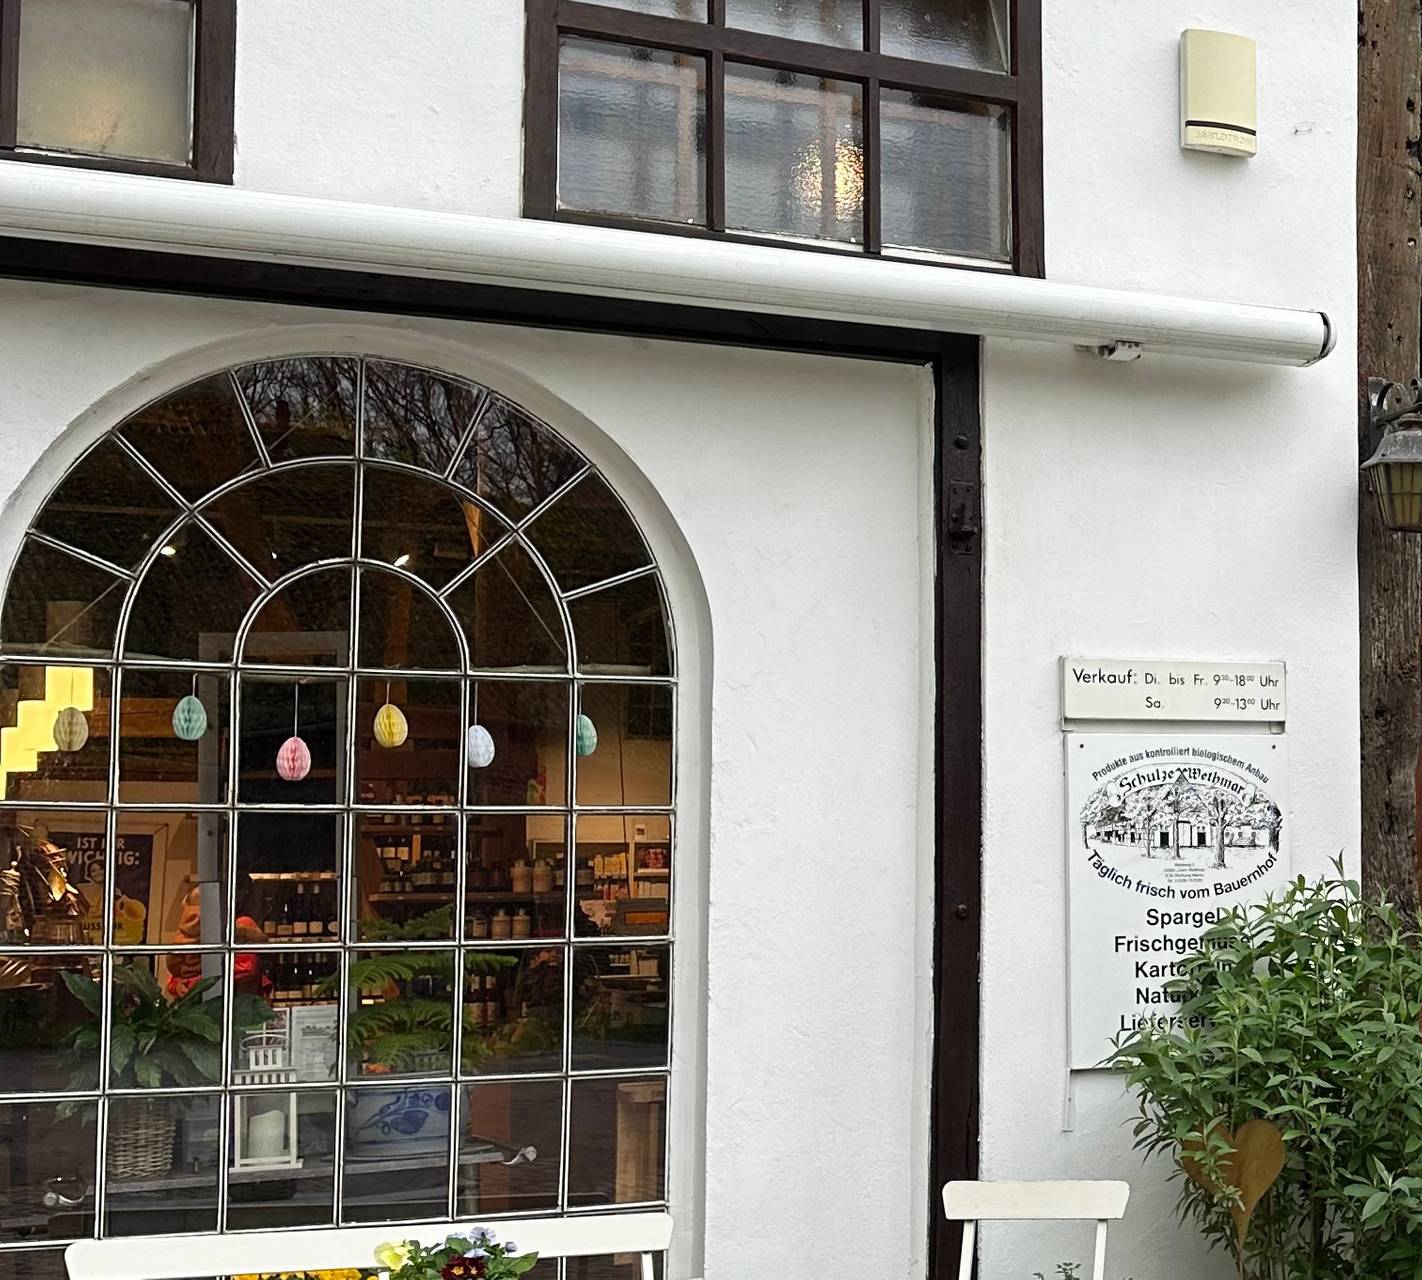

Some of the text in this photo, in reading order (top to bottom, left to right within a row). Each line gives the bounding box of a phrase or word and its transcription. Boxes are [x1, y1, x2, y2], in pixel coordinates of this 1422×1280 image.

[1072, 667, 1138, 684] Verkauf:
[1145, 672, 1161, 685] Di.
[1169, 672, 1186, 685] bis
[1193, 674, 1208, 687] Fr.
[1260, 675, 1279, 687] Uhr
[1145, 696, 1165, 709] Sa.
[1260, 698, 1280, 710] Uhr
[1092, 746, 1269, 784] Produkte aus kontrolliert biologischem Anbau
[1119, 767, 1245, 797] Schulze Wethmar
[67, 850, 140, 866] WICHIG:
[1087, 849, 1132, 890] Täglich
[1135, 880, 1175, 900] frisch
[1180, 888, 1211, 900] vom
[1213, 850, 1279, 896] Bauernhof
[1146, 907, 1221, 929] Spargel
[1135, 960, 1233, 979] Kartoln
